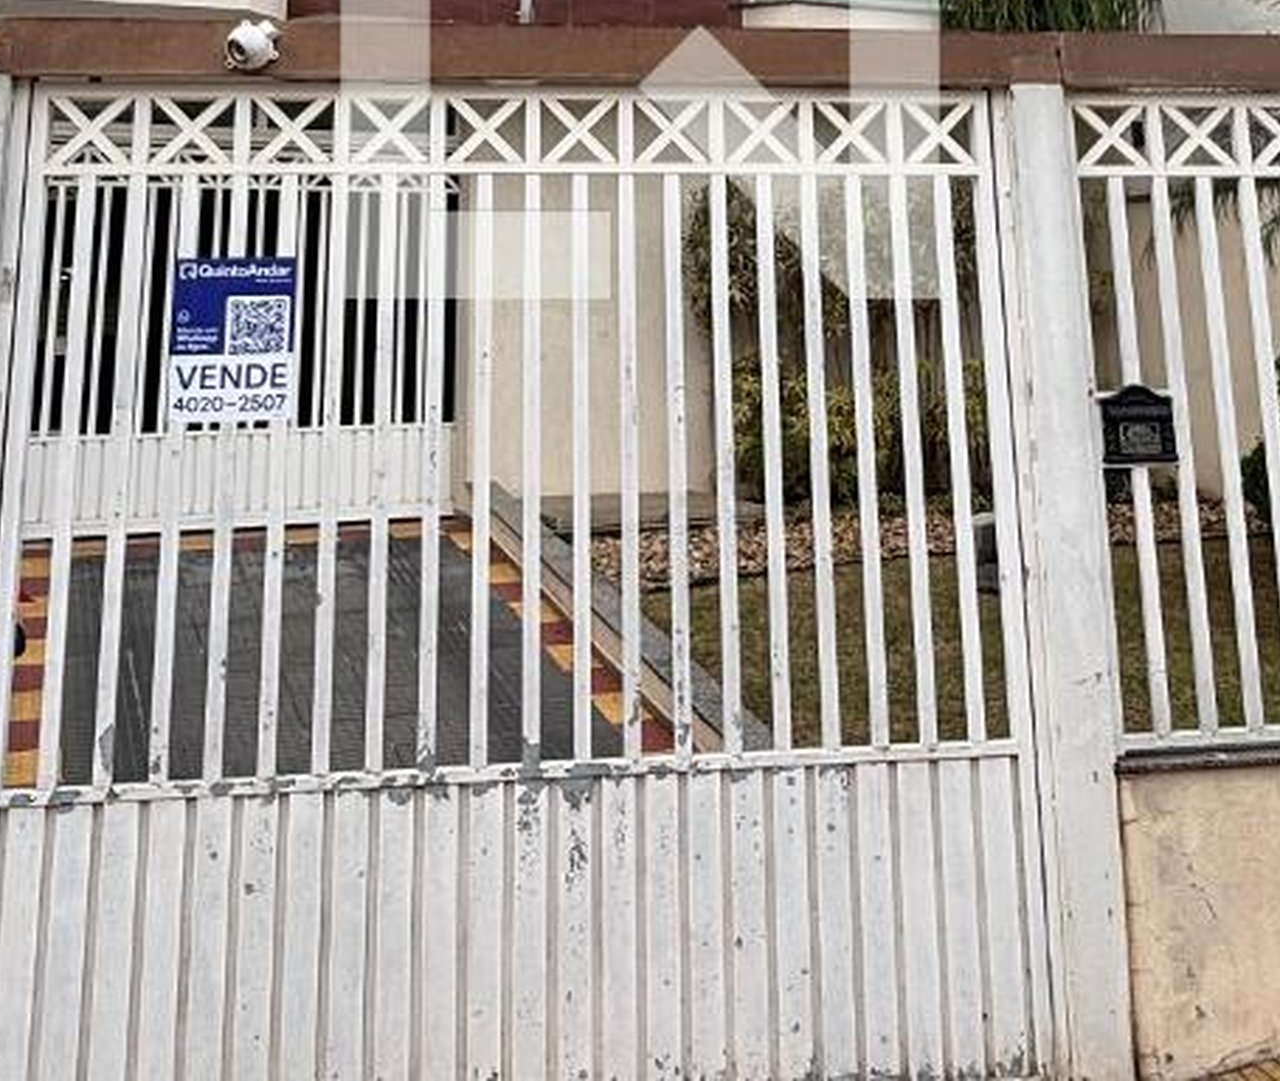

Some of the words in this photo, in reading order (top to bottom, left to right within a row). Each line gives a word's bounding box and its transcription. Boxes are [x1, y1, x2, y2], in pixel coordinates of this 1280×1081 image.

[198, 263, 293, 278] QuintoAndar
[175, 363, 288, 390] VENDE
[173, 394, 288, 412] 4020-2507
